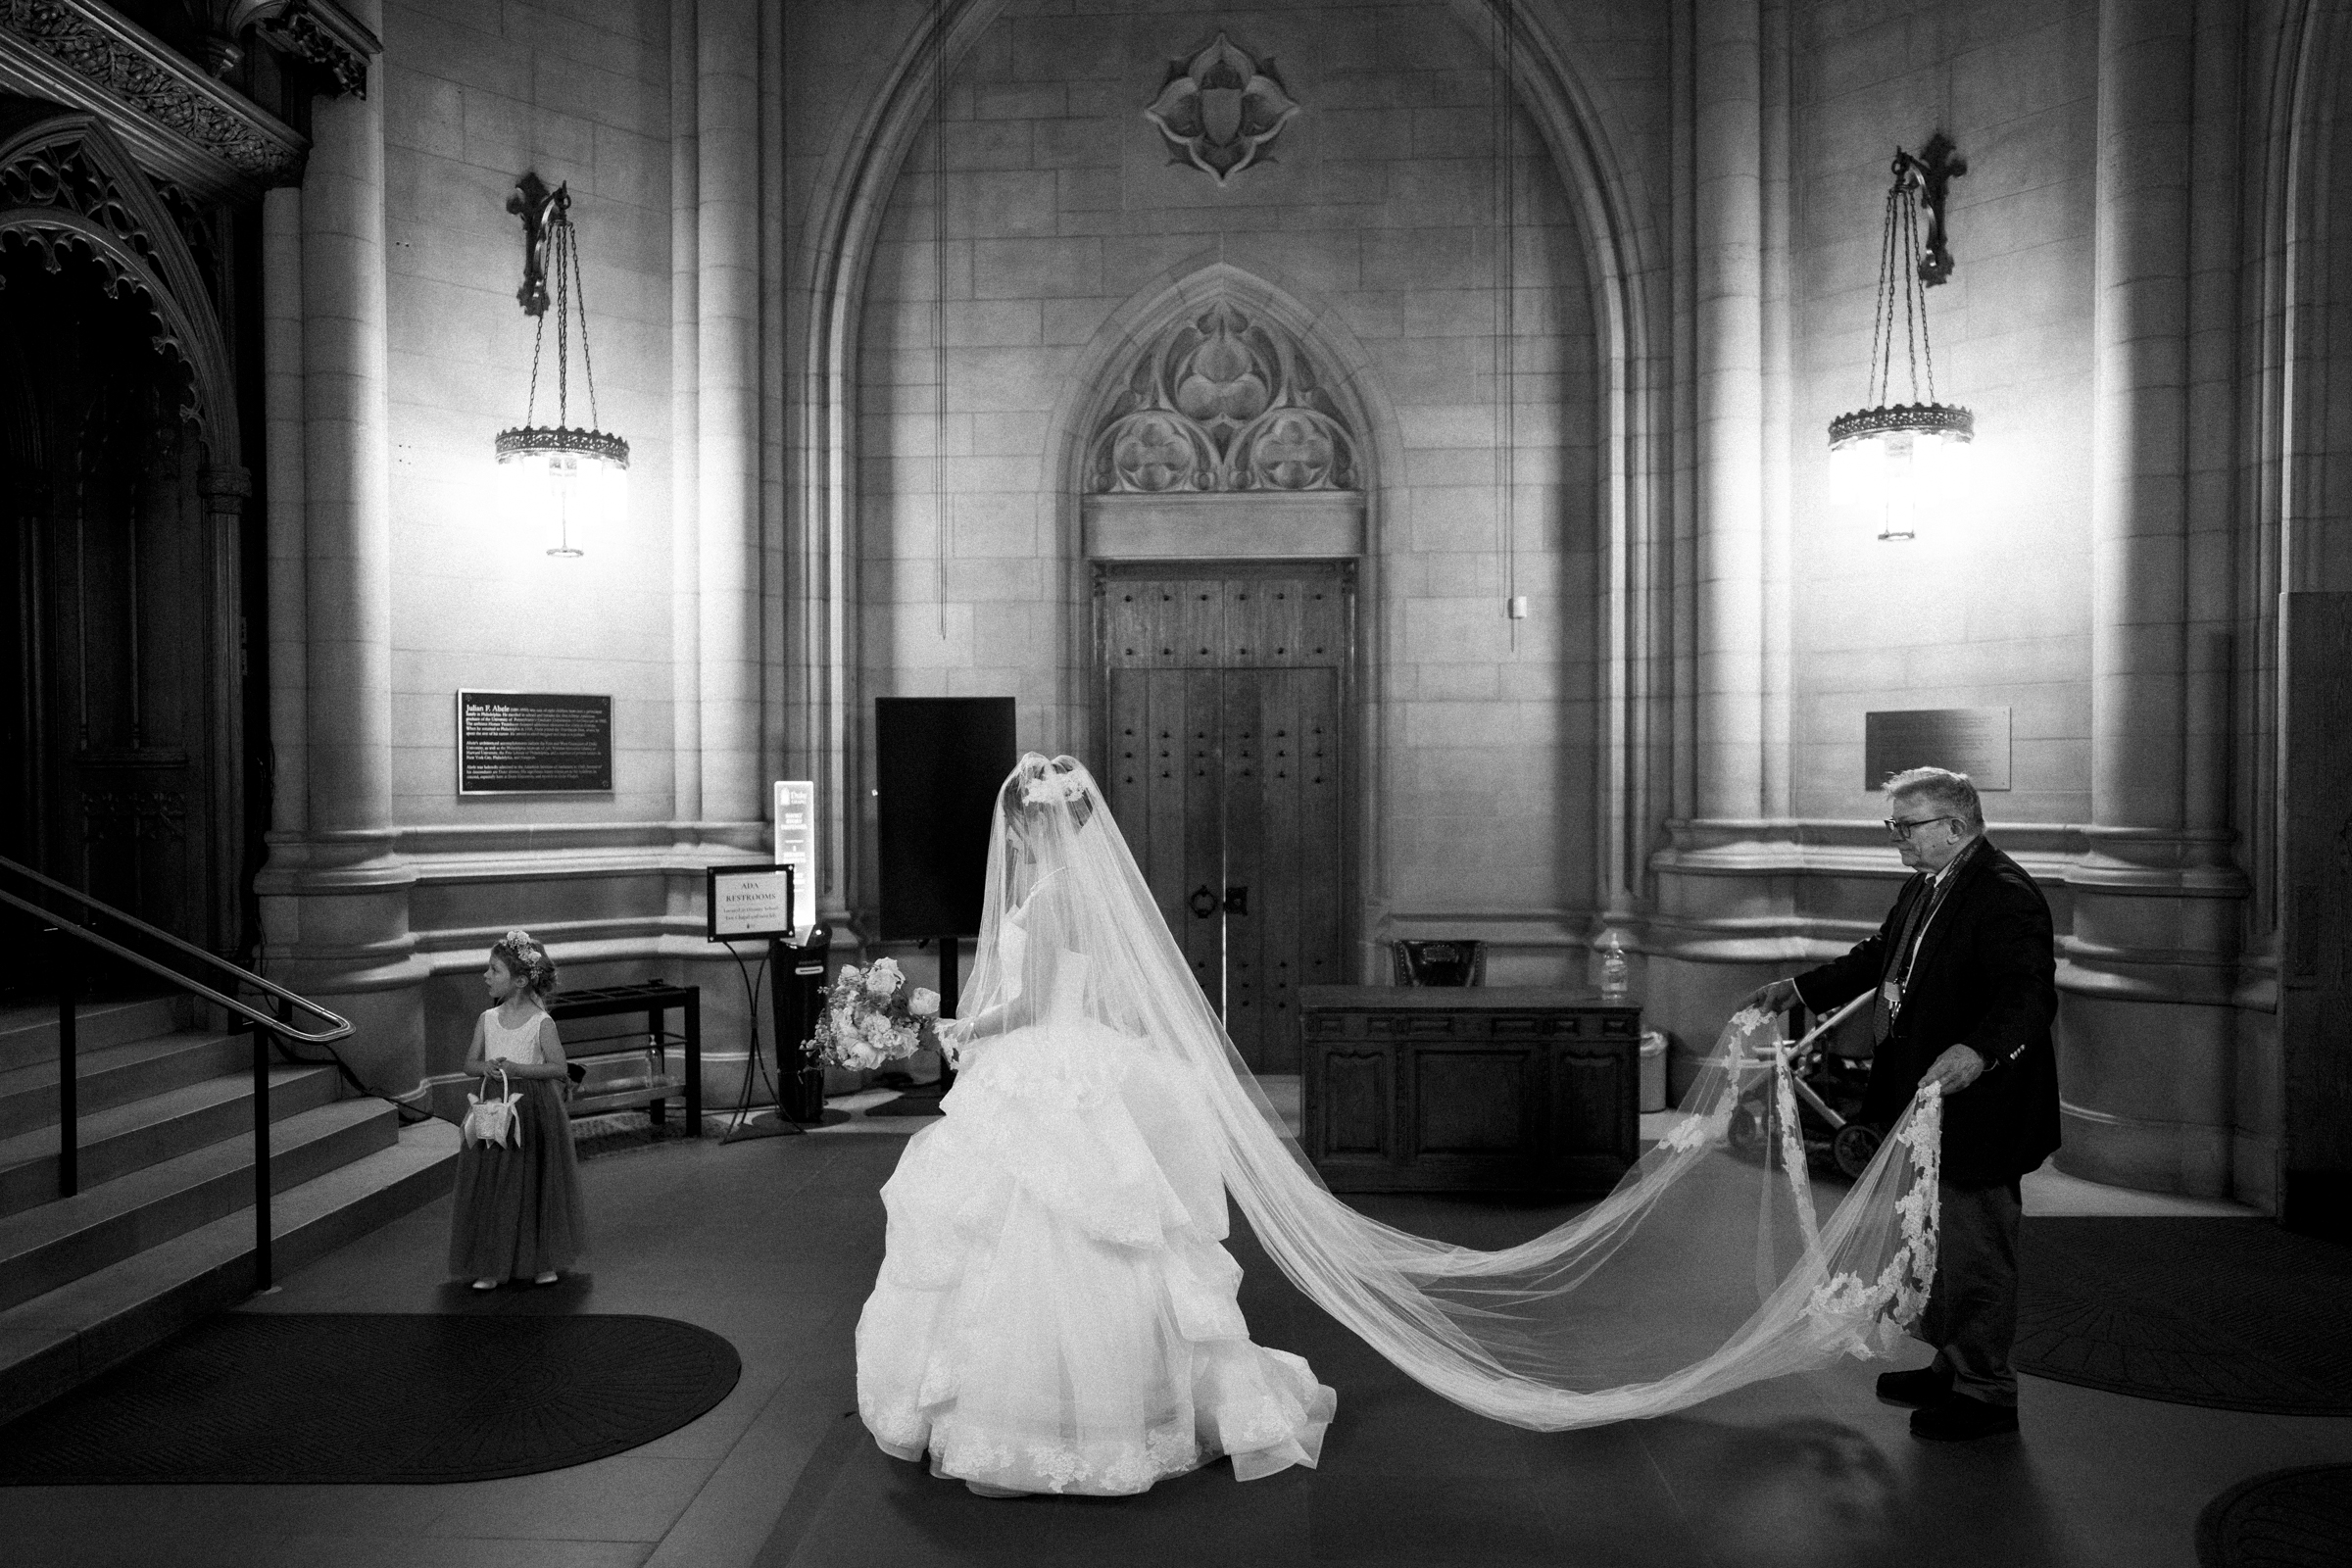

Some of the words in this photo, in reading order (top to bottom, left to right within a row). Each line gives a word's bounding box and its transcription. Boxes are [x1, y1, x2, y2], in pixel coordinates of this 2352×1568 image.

[466, 705, 484, 713] Julian
[492, 705, 511, 713] Abele
[790, 791, 808, 800] Duke
[726, 893, 776, 903] RESTROOMS
